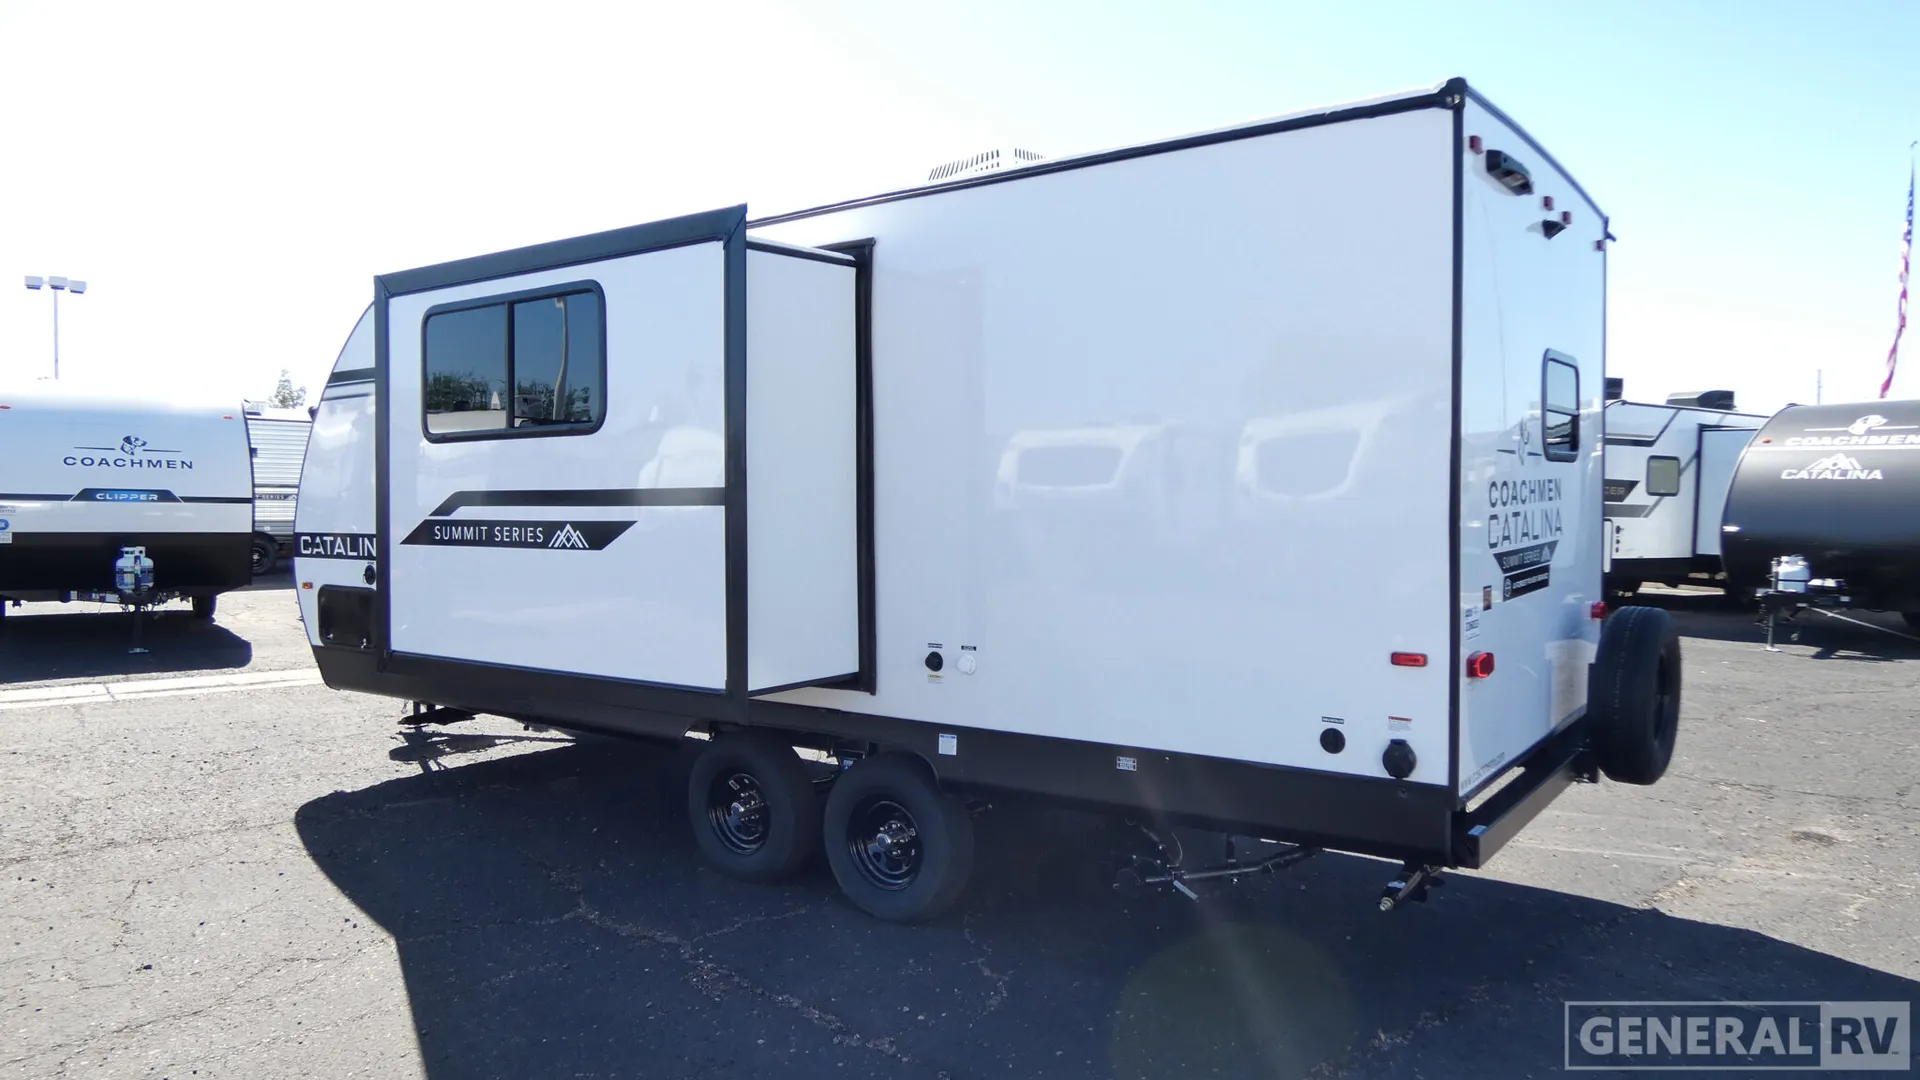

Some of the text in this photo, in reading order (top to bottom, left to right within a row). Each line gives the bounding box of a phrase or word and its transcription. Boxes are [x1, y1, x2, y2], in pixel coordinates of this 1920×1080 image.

[1785, 435, 1920, 445] COACHMEN
[63, 456, 194, 470] COACHMEN
[1781, 469, 1883, 480] CATALINA
[95, 493, 158, 501] CLIPPER
[1489, 479, 1561, 508] COACHMEN
[1603, 484, 1626, 496] CER
[434, 525, 544, 543] SUMMIT SERIES
[1488, 508, 1563, 549] CATALINA
[300, 535, 377, 557] CATALIN
